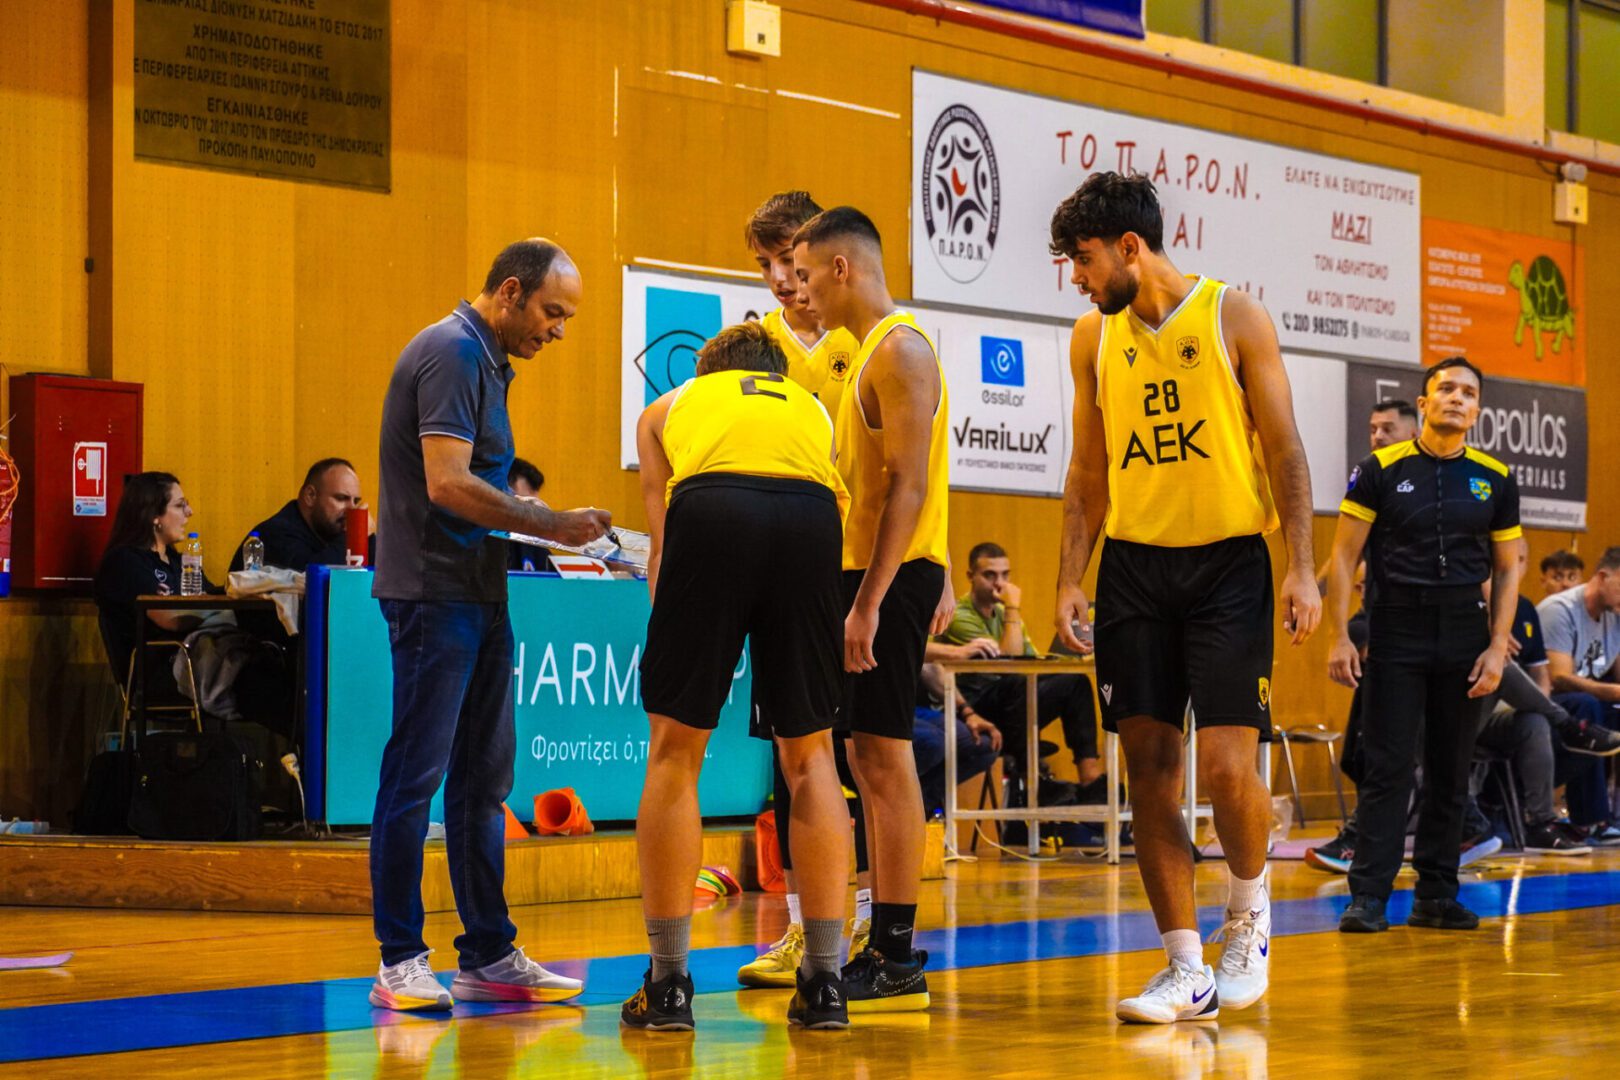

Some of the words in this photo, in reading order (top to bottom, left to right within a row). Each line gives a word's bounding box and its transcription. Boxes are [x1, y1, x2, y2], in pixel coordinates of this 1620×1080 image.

[258, 7, 316, 31] ΧΑΤΖΙΔΑΚΗ
[319, 17, 333, 33] ΤΟ
[334, 21, 361, 39] ΕΤΟΣ
[193, 23, 324, 60] ΧΡΗΜΑΤΟΔΟΤΗΘΗΚΕ
[142, 58, 228, 87] ΠΕΡΙΦΕΡΕΙΑΡΧΕΣ
[230, 74, 268, 93] ΙΩΑΝΝΗ
[185, 44, 207, 61] ΑΠΟ
[209, 48, 228, 64] ΤΗΝ
[230, 51, 289, 74] ΠΕΡΙΦΕΡΕΙΑ
[291, 61, 330, 82] ΑΤΤΙΚΗΣ
[143, 108, 189, 130] ΟΚΤΩΒΡΙΟ
[191, 115, 208, 133] ΤΟΥ
[209, 119, 230, 135] 2017
[230, 121, 249, 139] ΑΠΟ
[207, 96, 309, 127] ΕΓΚΑΙΝΙΑΣΘΗΚΕ
[199, 138, 249, 160] ΠΡΟΚΟΠΗ
[250, 145, 317, 169] ΠΑΥΛΟΠΟΥΛΟ
[1056, 129, 1098, 171] ΤΟ
[1284, 165, 1321, 189] ΕΛΑΤΕ
[1324, 174, 1341, 193] ΝΑ
[1330, 210, 1373, 244] ΜΑΖΙ
[981, 388, 1026, 409] essilor
[1143, 378, 1181, 417] 28
[1120, 418, 1211, 470] AEK
